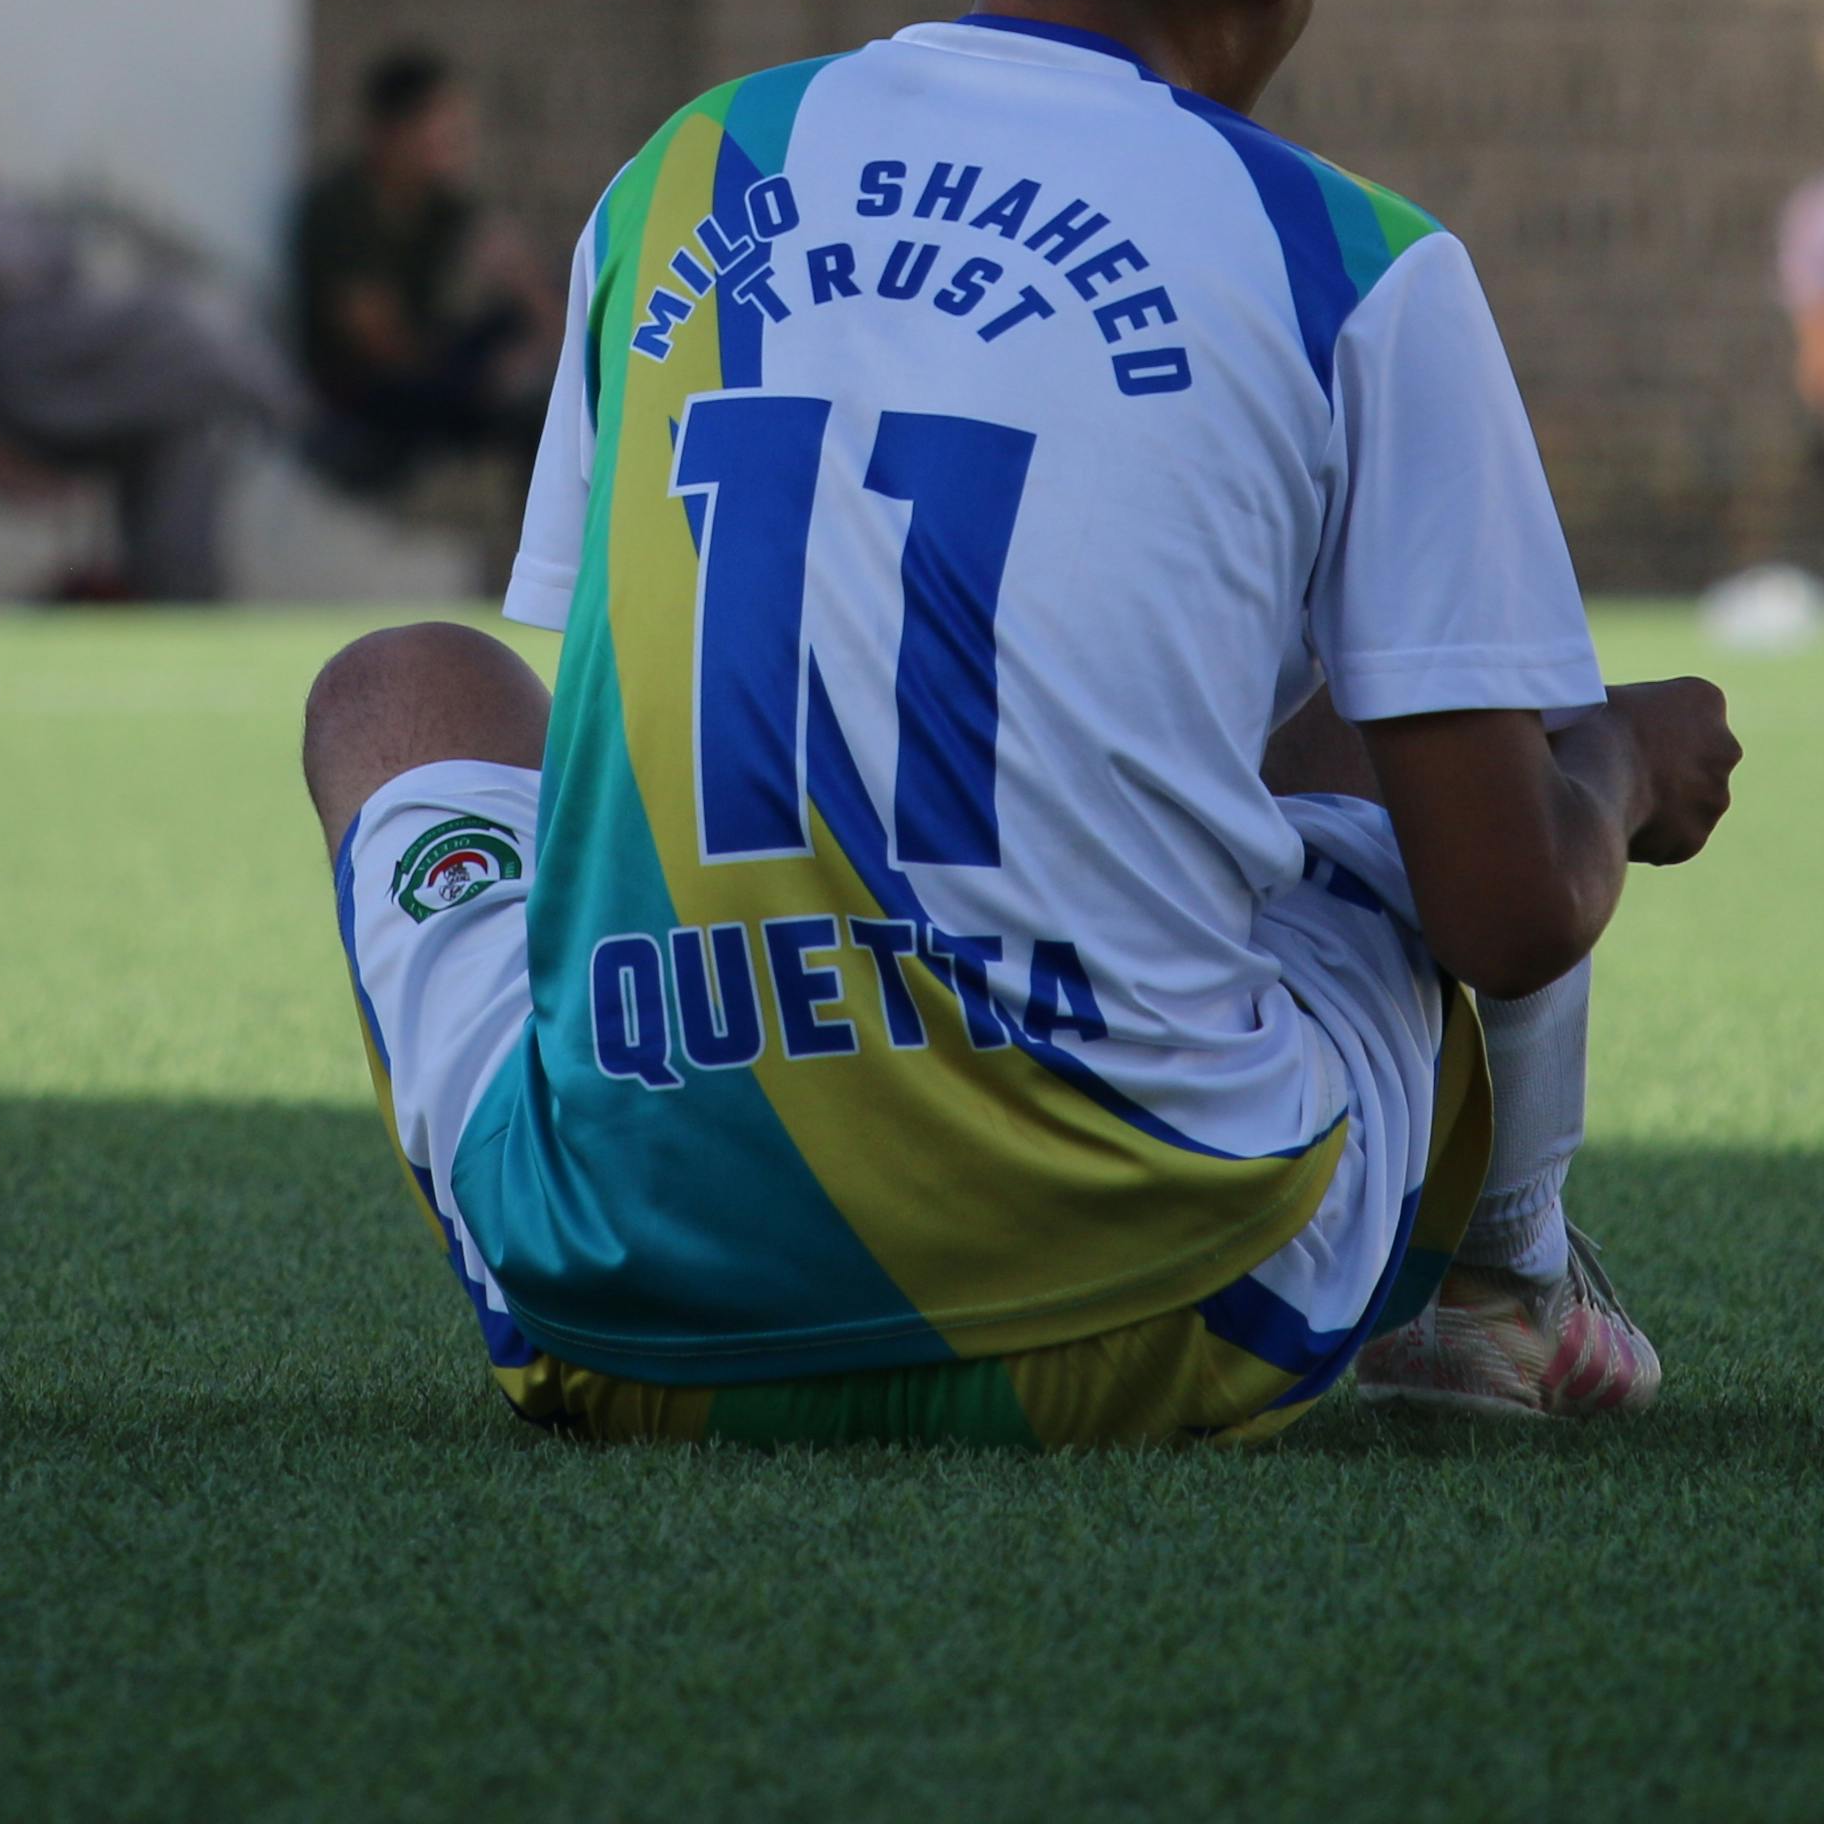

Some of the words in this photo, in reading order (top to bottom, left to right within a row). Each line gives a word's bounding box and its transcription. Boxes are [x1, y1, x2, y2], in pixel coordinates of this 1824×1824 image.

[630, 173, 801, 363] MILO
[856, 160, 1192, 397] SHAHEED
[733, 240, 1056, 343] TRUST
[668, 389, 1037, 870] 11
[589, 914, 1108, 1091] QUETTA
